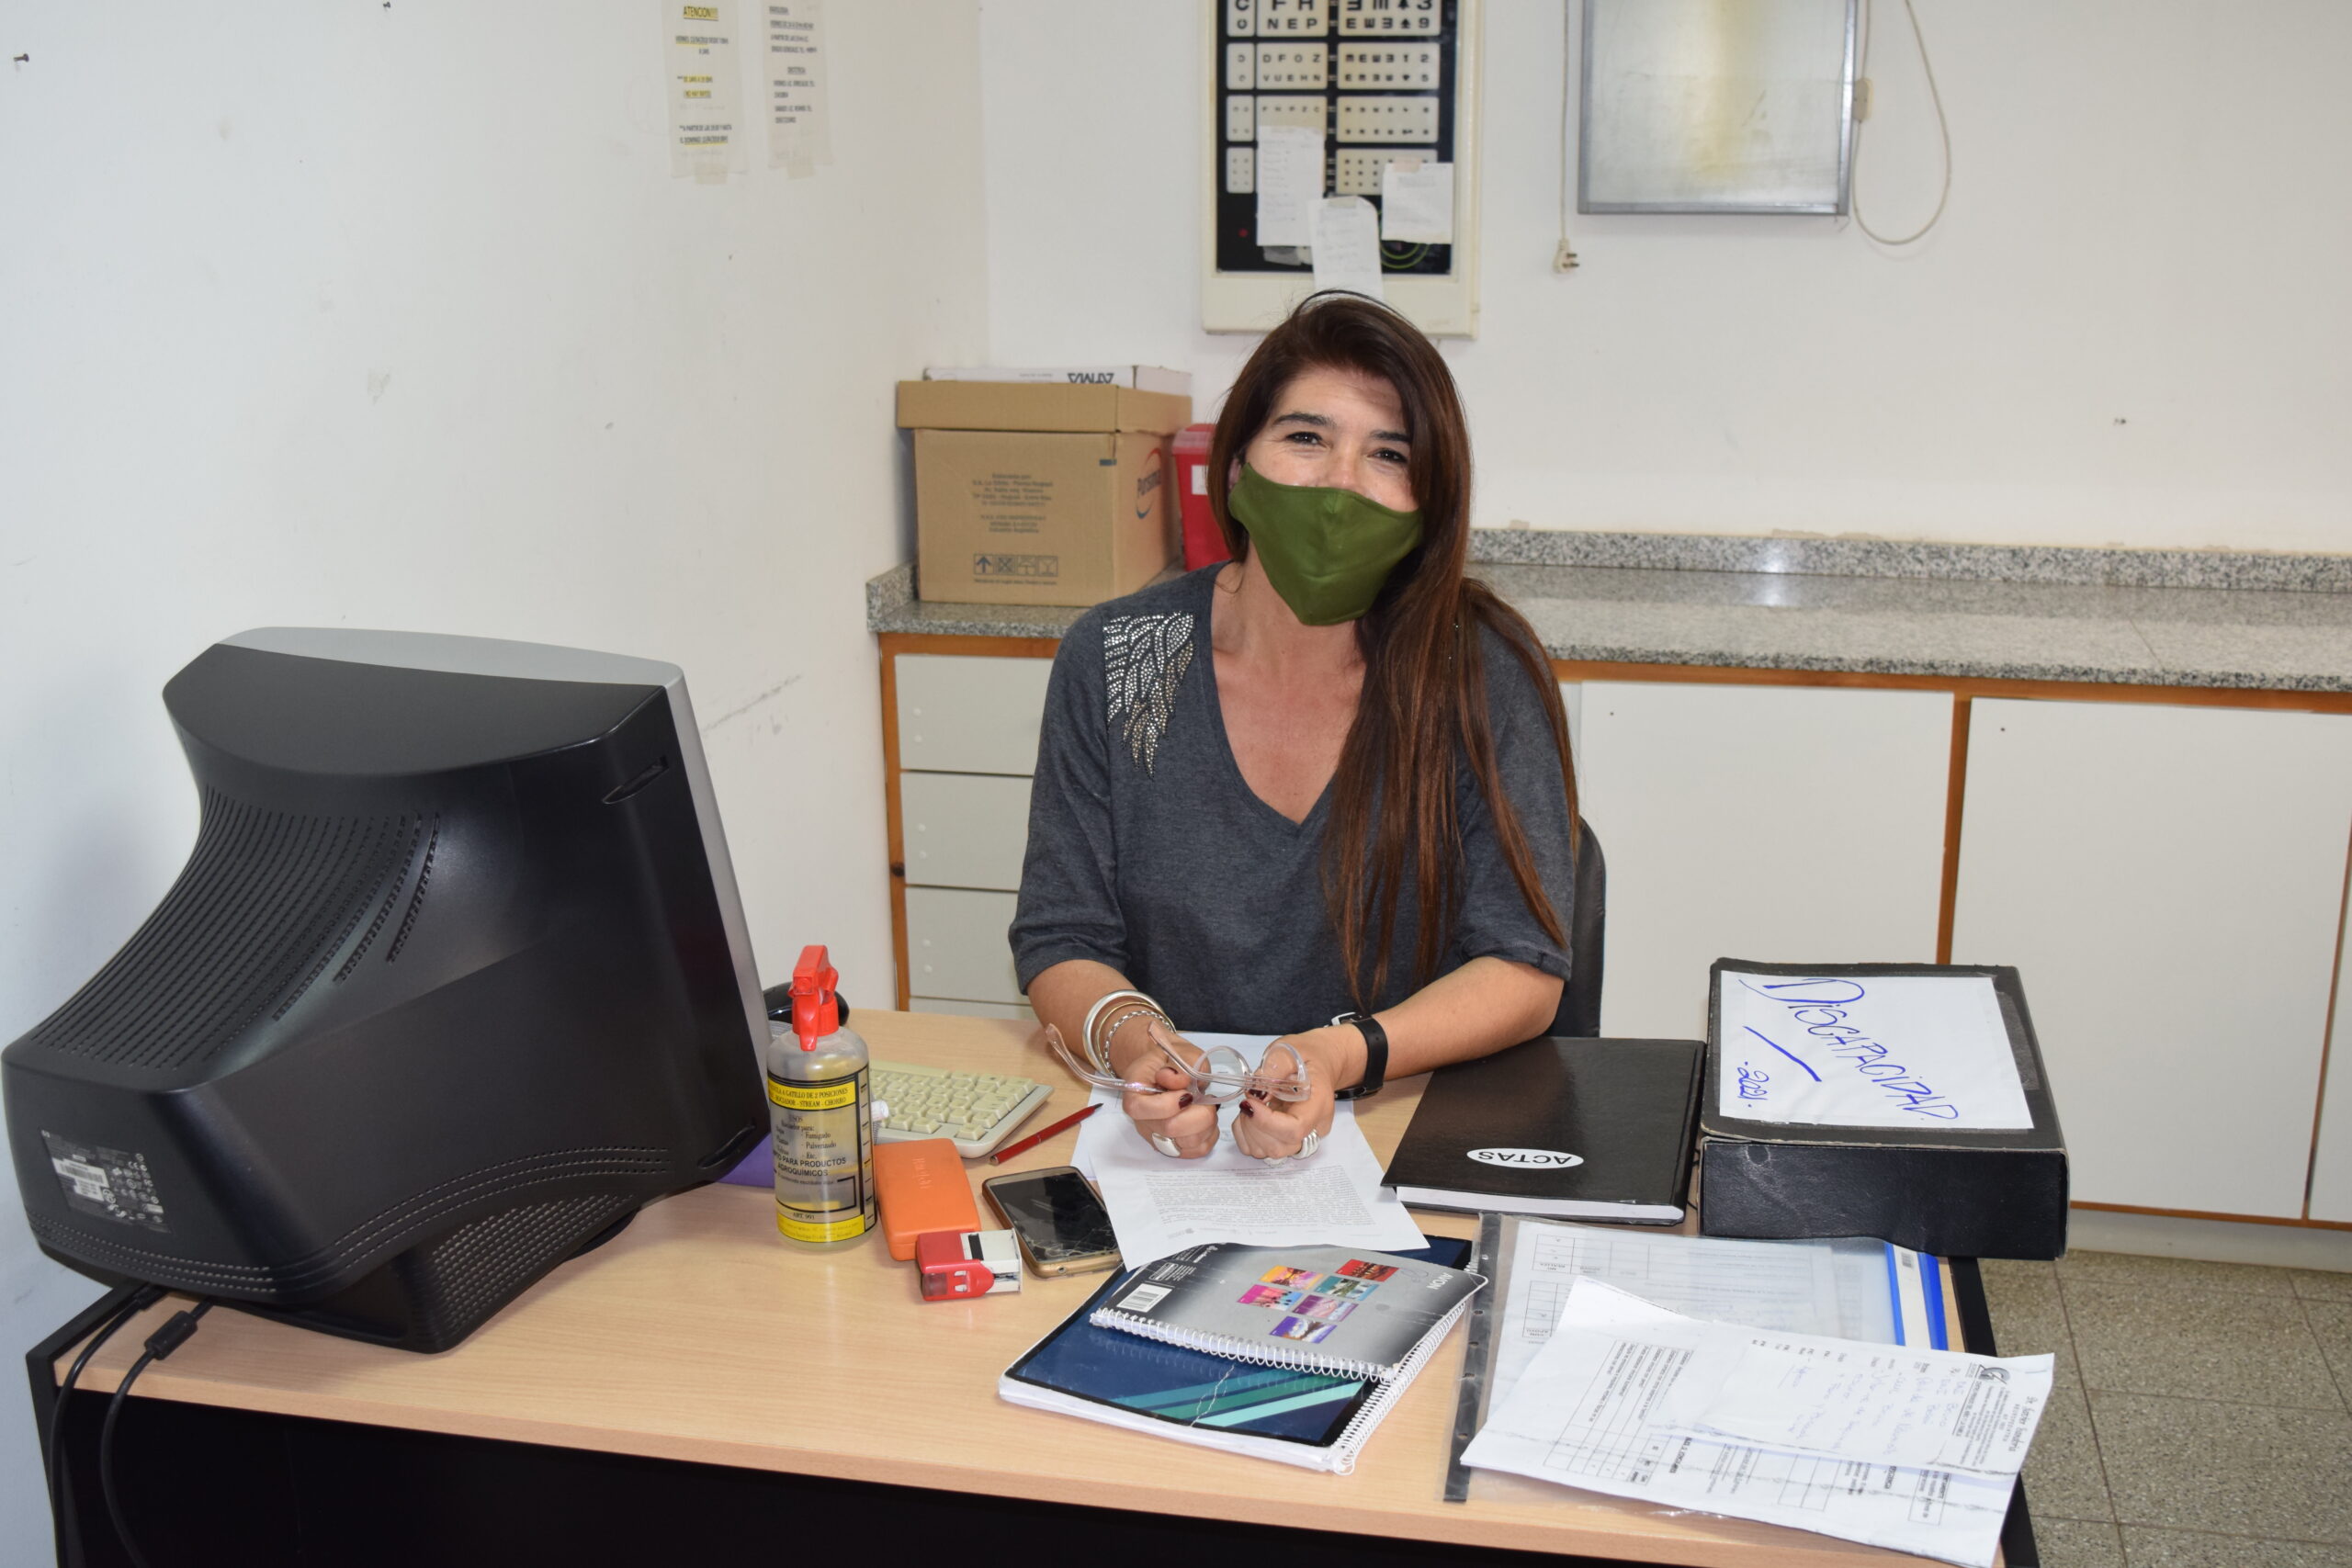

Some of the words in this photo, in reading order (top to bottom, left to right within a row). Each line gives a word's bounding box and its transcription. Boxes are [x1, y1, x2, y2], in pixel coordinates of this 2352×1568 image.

[783, 1156, 798, 1167] PARA
[799, 1156, 847, 1168] PRODUCTOS
[1478, 1151, 1572, 1165] ACTAS
